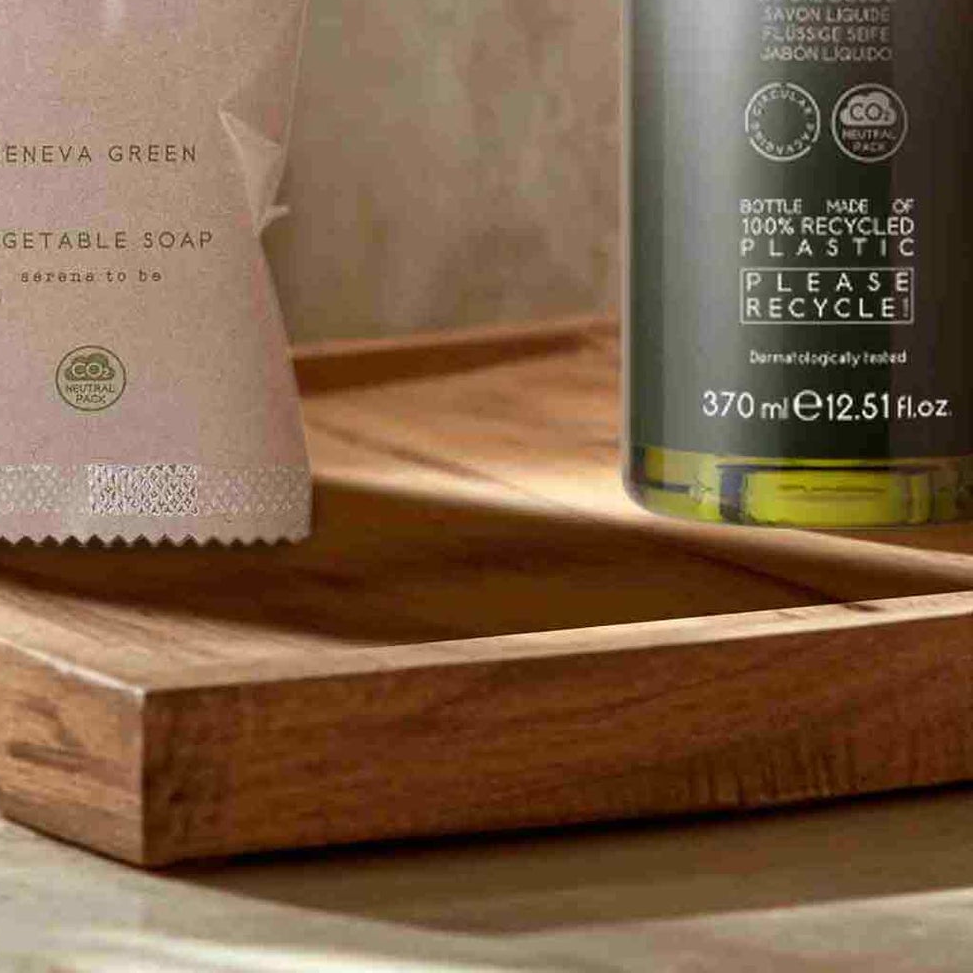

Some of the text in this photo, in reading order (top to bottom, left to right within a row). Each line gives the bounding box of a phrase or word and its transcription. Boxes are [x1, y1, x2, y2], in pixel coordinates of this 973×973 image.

[763, 6, 821, 22] SAVON
[107, 144, 197, 164] GREEN
[740, 199, 914, 214] BOTTLE MADE OF
[741, 217, 914, 235] 100% RECYCLED
[143, 231, 214, 250] SOAP
[740, 238, 915, 257] PLASTIC
[106, 267, 127, 283] to
[138, 267, 163, 283] be
[745, 272, 910, 293] PLEASE
[745, 297, 910, 319] RECYCLE!
[66, 383, 115, 393] NEUTRAL
[702, 390, 755, 418] 370
[760, 397, 789, 419] ml
[827, 393, 890, 421] 12.51
